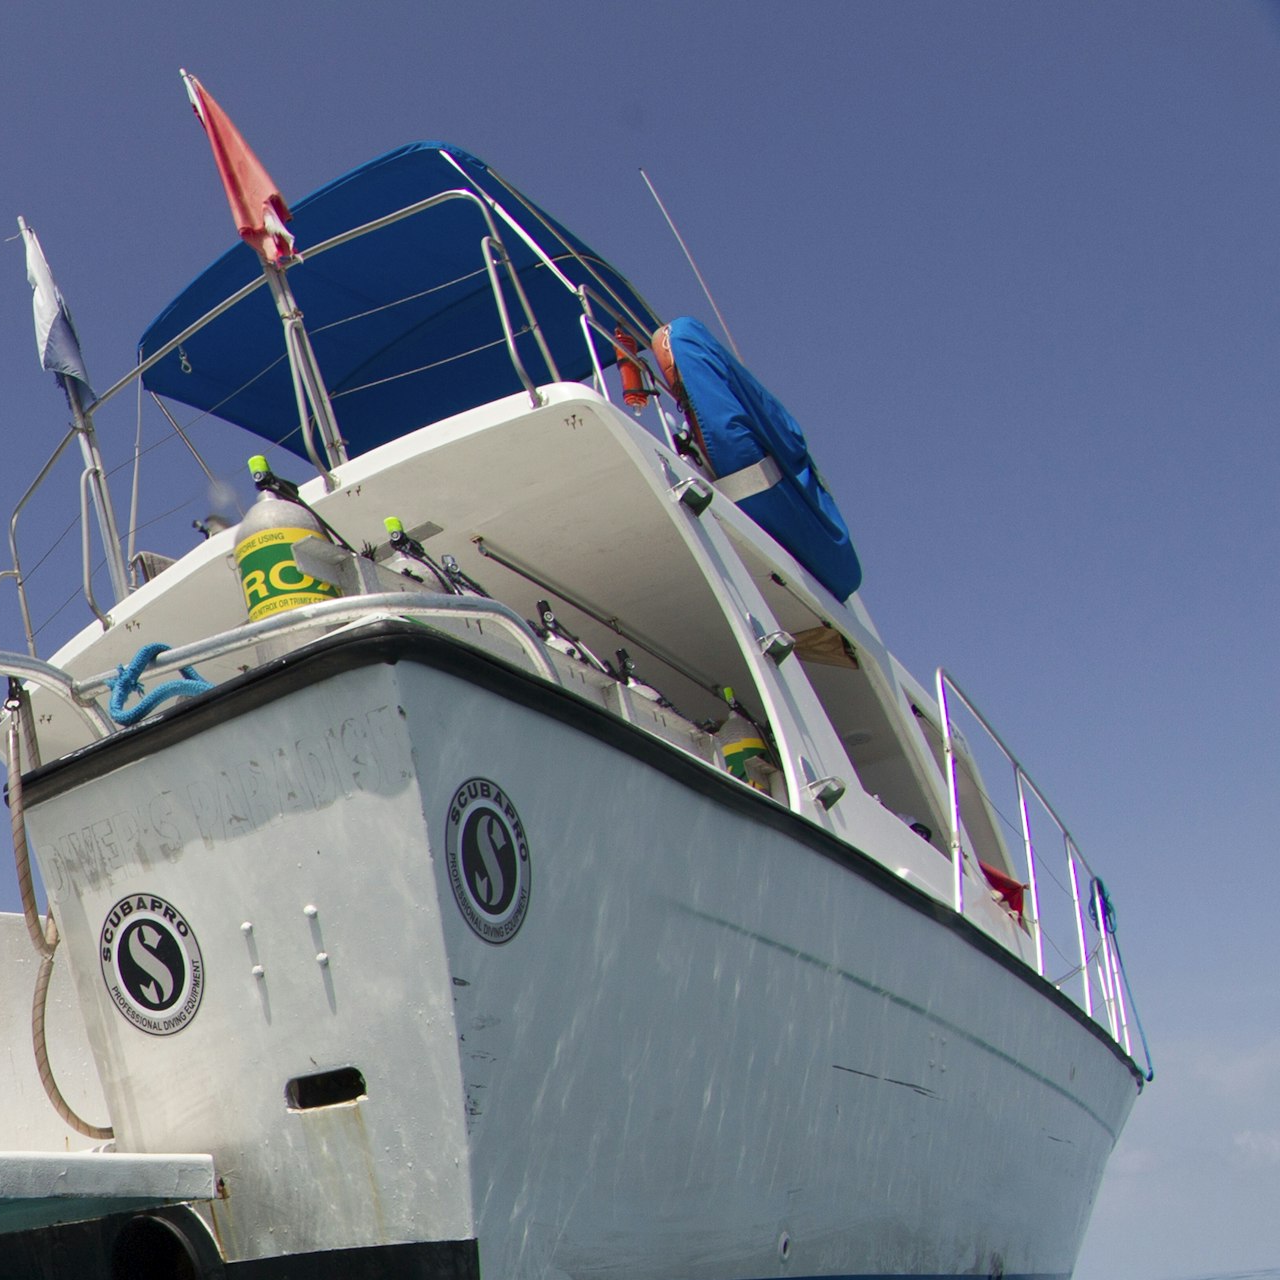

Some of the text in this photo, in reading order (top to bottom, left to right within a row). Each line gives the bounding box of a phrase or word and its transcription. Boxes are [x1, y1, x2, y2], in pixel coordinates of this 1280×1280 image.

[258, 532, 284, 545] USING
[243, 560, 344, 608] RO
[279, 599, 289, 607] OR
[451, 782, 528, 863] SCUBAPRO
[449, 852, 528, 938] PROFESSIONAL DIVING EQUIPMENT
[102, 897, 189, 963] SCUBAPRO
[111, 959, 201, 1031] PROFESSIONAL DIVING EQUIPMENT
